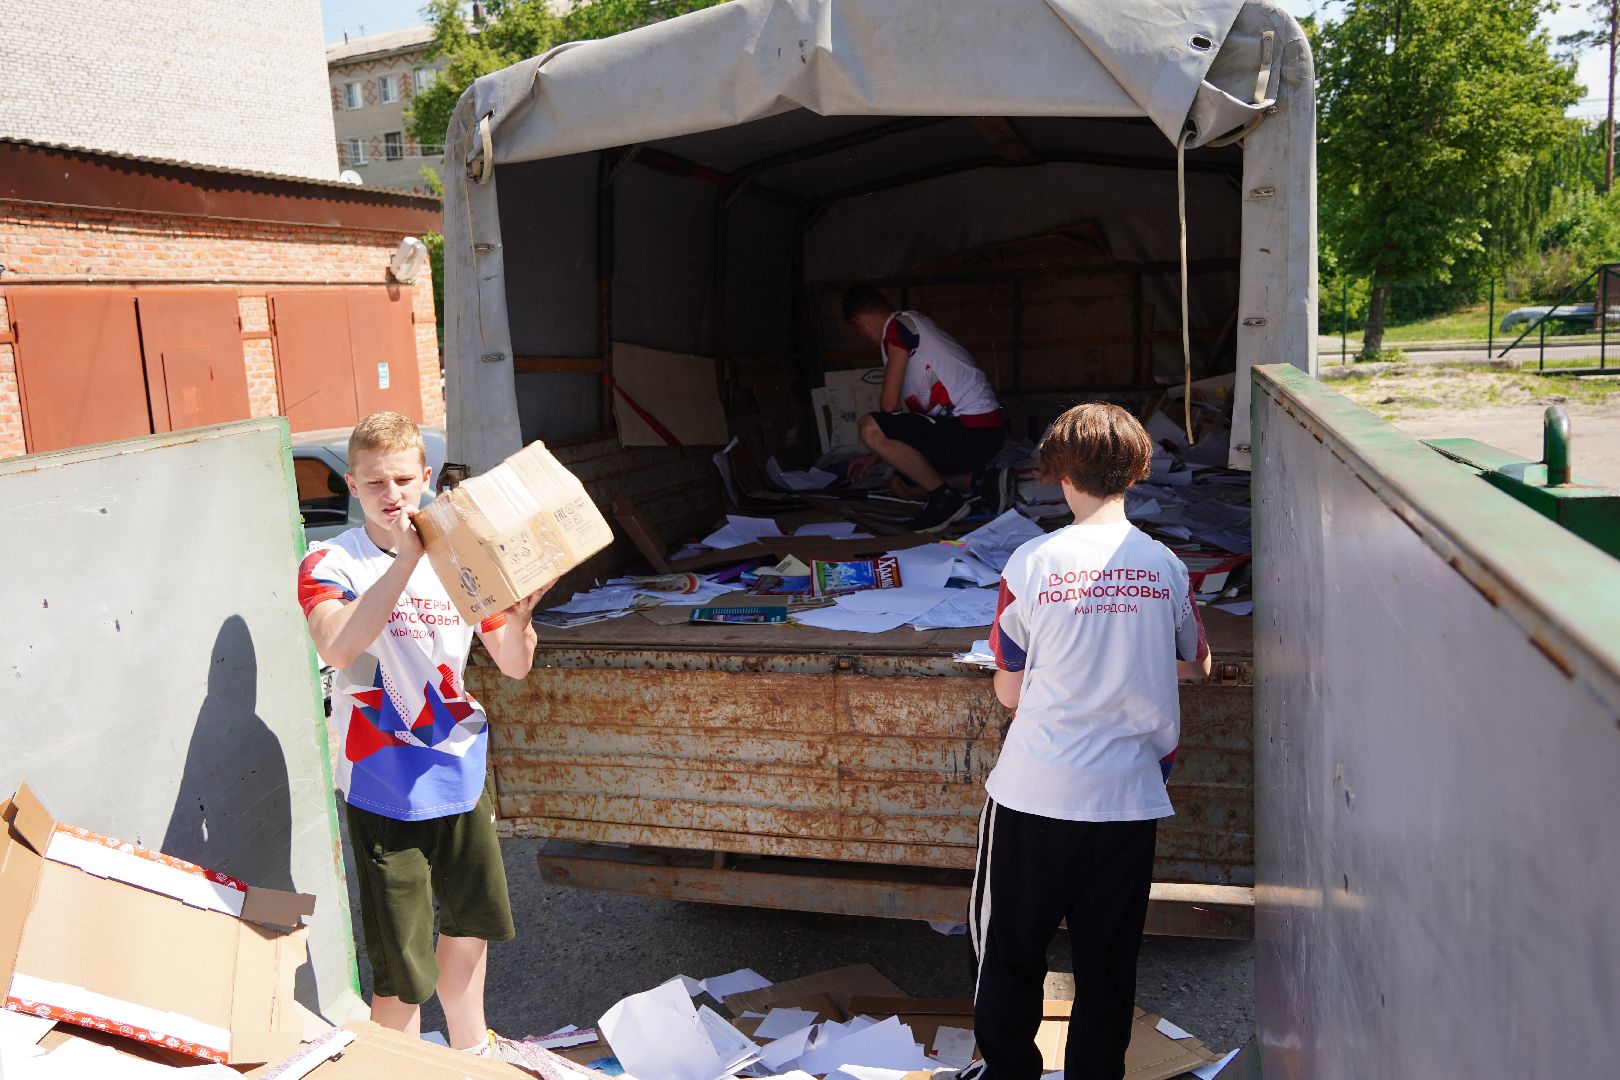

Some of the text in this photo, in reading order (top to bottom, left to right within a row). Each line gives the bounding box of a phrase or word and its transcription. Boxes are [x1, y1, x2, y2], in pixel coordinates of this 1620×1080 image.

[1049, 568, 1160, 587] ВОЛОНТЕРЫ
[1038, 585, 1170, 605] ПОДМОСКОВЬЯ
[396, 597, 451, 611] ОНТЕРЫ
[1074, 603, 1138, 616] МЫ РЯДОМ
[388, 611, 460, 626] МОСКОВЬЯ
[390, 628, 408, 638] МЫ
